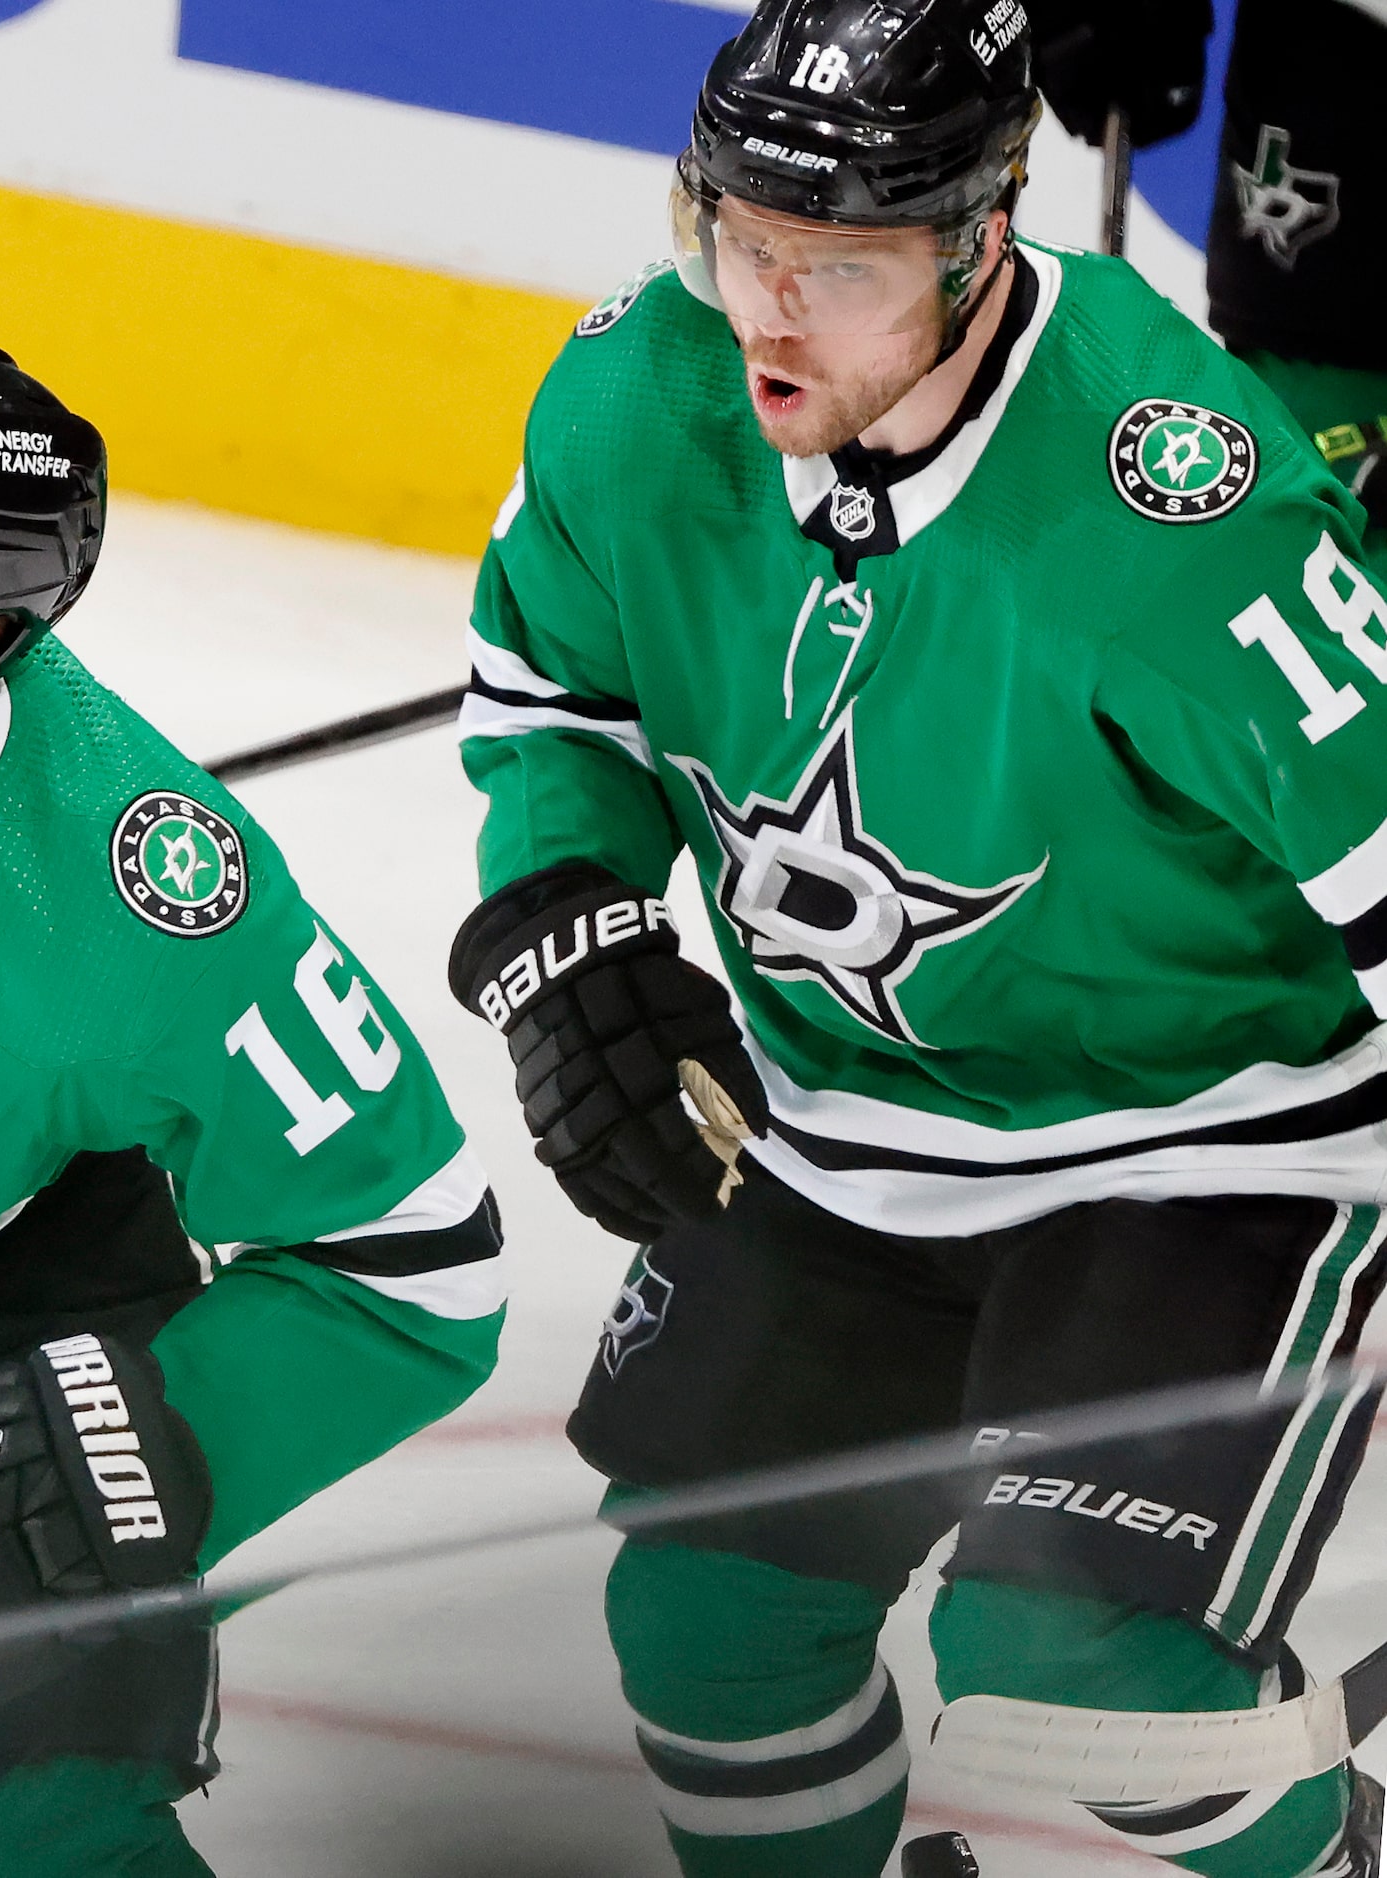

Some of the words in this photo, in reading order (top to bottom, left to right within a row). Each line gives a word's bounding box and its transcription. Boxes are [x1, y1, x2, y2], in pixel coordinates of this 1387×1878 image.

[789, 43, 850, 94] 18
[742, 137, 838, 173] BAUER
[1119, 405, 1212, 490] DALLAS
[1165, 440, 1247, 514] STARS
[839, 501, 865, 526] NHL
[1226, 529, 1387, 746] 18
[123, 800, 195, 904] DALLAS
[181, 837, 240, 927] STARS
[479, 898, 681, 1032] BAUER
[223, 918, 401, 1158] 16
[39, 1332, 167, 1544] ARRIOR
[983, 1474, 1219, 1551] BAUER
